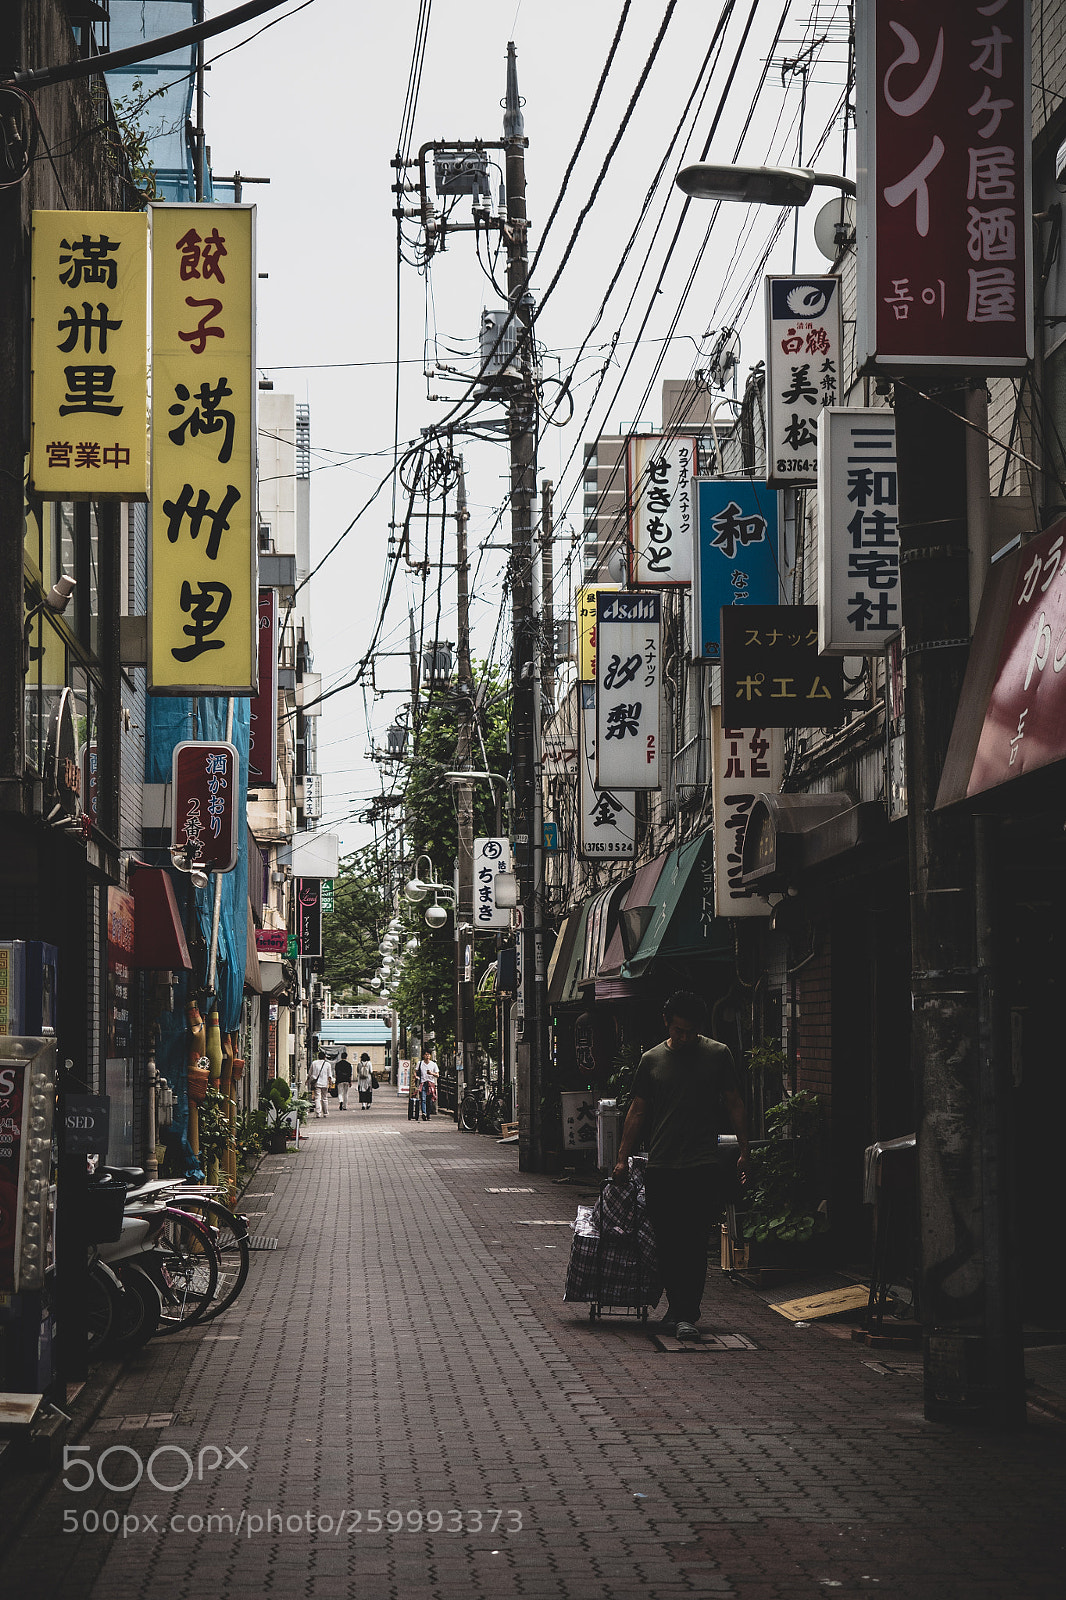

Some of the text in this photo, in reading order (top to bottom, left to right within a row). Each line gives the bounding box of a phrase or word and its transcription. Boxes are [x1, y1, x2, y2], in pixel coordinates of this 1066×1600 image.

[967, 0, 1016, 323] オケ居酒屋
[175, 228, 228, 354] 餃子
[781, 327, 831, 356] 白鶴
[781, 363, 818, 450] 美松
[46, 440, 131, 469] 営業中
[646, 456, 672, 572] せきもと
[678, 448, 691, 533] カラオケ スナック
[709, 501, 767, 559] 和
[847, 428, 899, 631] 三和住宅社
[1018, 535, 1066, 605] カラ
[603, 598, 655, 620] Asahi
[744, 629, 819, 647] スナック
[645, 639, 657, 688] スナック
[736, 672, 832, 701] ポエム
[646, 734, 656, 764] 2F
[206, 753, 228, 839] 酒かおり
[478, 866, 493, 921] ちまき
[699, 860, 712, 938] ショットバー
[65, 1116, 95, 1129] SED
